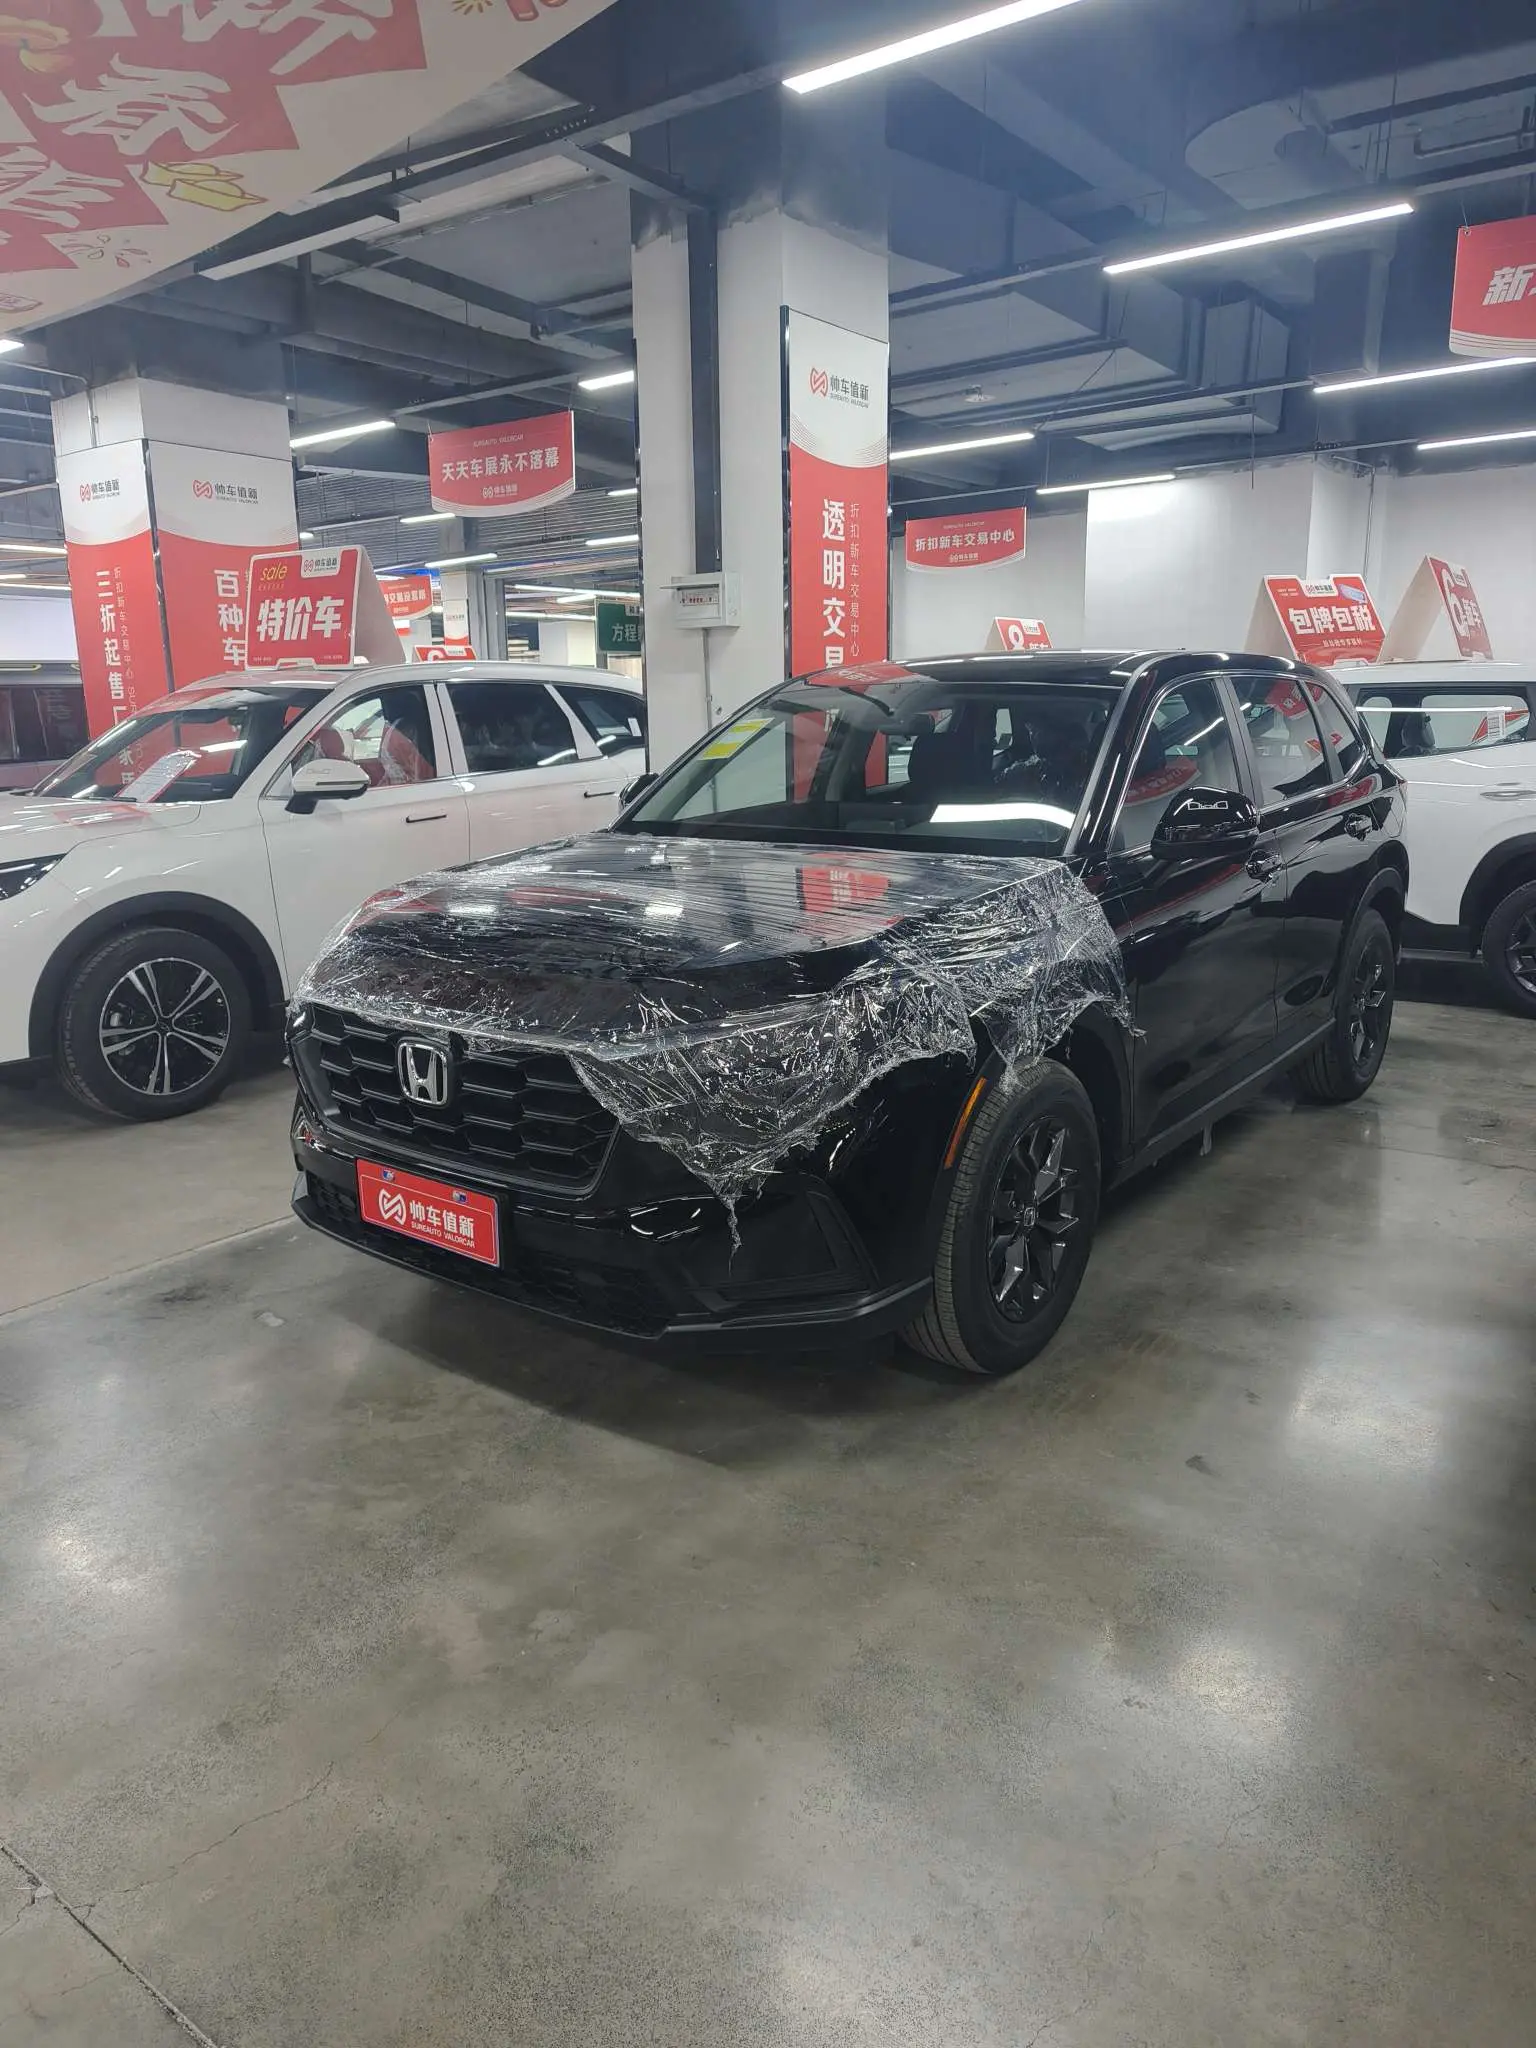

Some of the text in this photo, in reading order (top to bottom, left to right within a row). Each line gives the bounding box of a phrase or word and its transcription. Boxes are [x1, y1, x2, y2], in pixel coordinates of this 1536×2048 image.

[1482, 263, 1536, 306] 新
[830, 375, 869, 401] 帅车值新
[442, 447, 560, 482] 天天车展永不落幕
[915, 528, 1015, 552] 折扣新车交易中心
[260, 562, 287, 581] sale
[849, 503, 860, 657] 折扣新车交易中心
[214, 569, 247, 673] 百种车
[256, 596, 344, 642] 特价车
[612, 623, 641, 642] 方程
[1288, 605, 1376, 635] 包牌包税
[409, 1199, 475, 1239] 帅车值新
[411, 1221, 475, 1248] SUREAUTO VALORCAR
